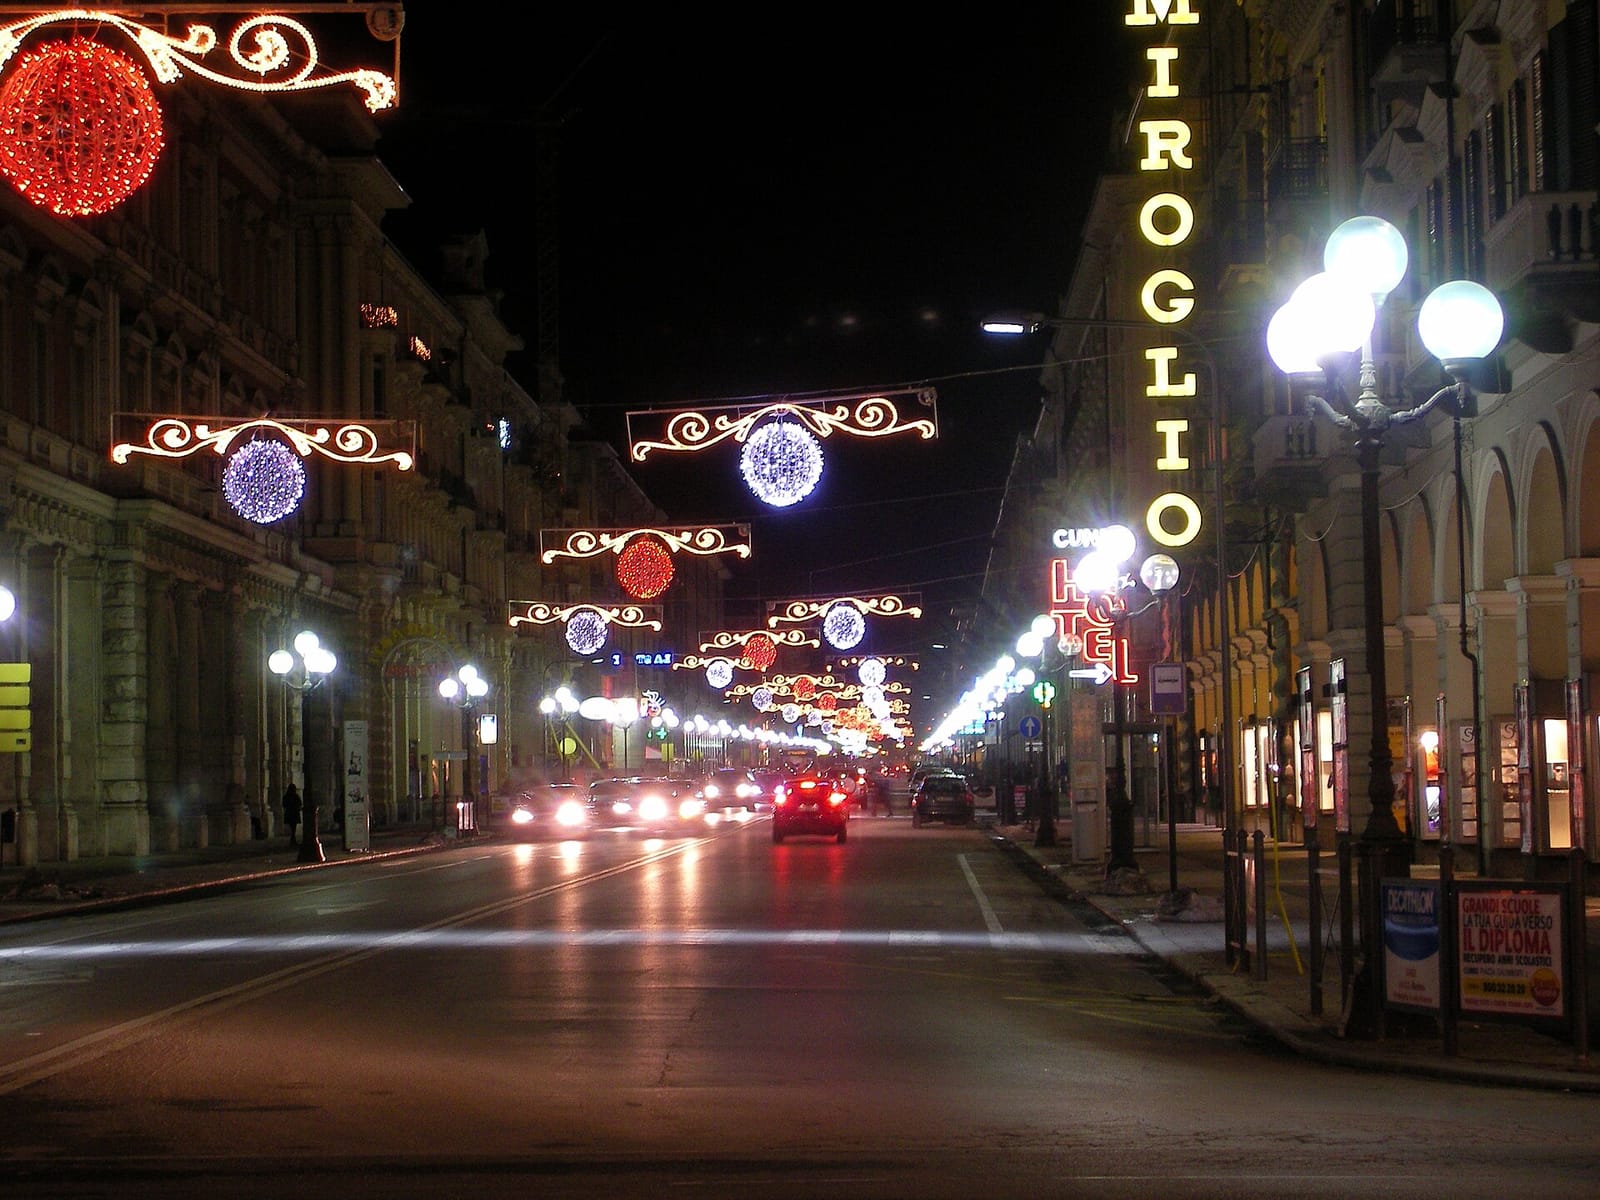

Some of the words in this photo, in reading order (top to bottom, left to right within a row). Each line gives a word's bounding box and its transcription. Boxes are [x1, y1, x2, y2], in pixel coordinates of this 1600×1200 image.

[1125, 0, 1202, 547] MIROGLIO
[1050, 559, 1139, 684] HOTEL
[1463, 897, 1499, 914] GRANDI
[1501, 898, 1540, 915] SCUOLE
[1463, 914, 1472, 928] LA
[1473, 914, 1491, 929] TUA
[1493, 915, 1520, 930] GUIDA
[1522, 916, 1553, 930] VERSO
[1463, 928, 1475, 953] IL
[1480, 929, 1552, 954] DIPLOMA
[1463, 954, 1496, 965] RECUPERO
[1515, 956, 1552, 968] SCOLASTICI
